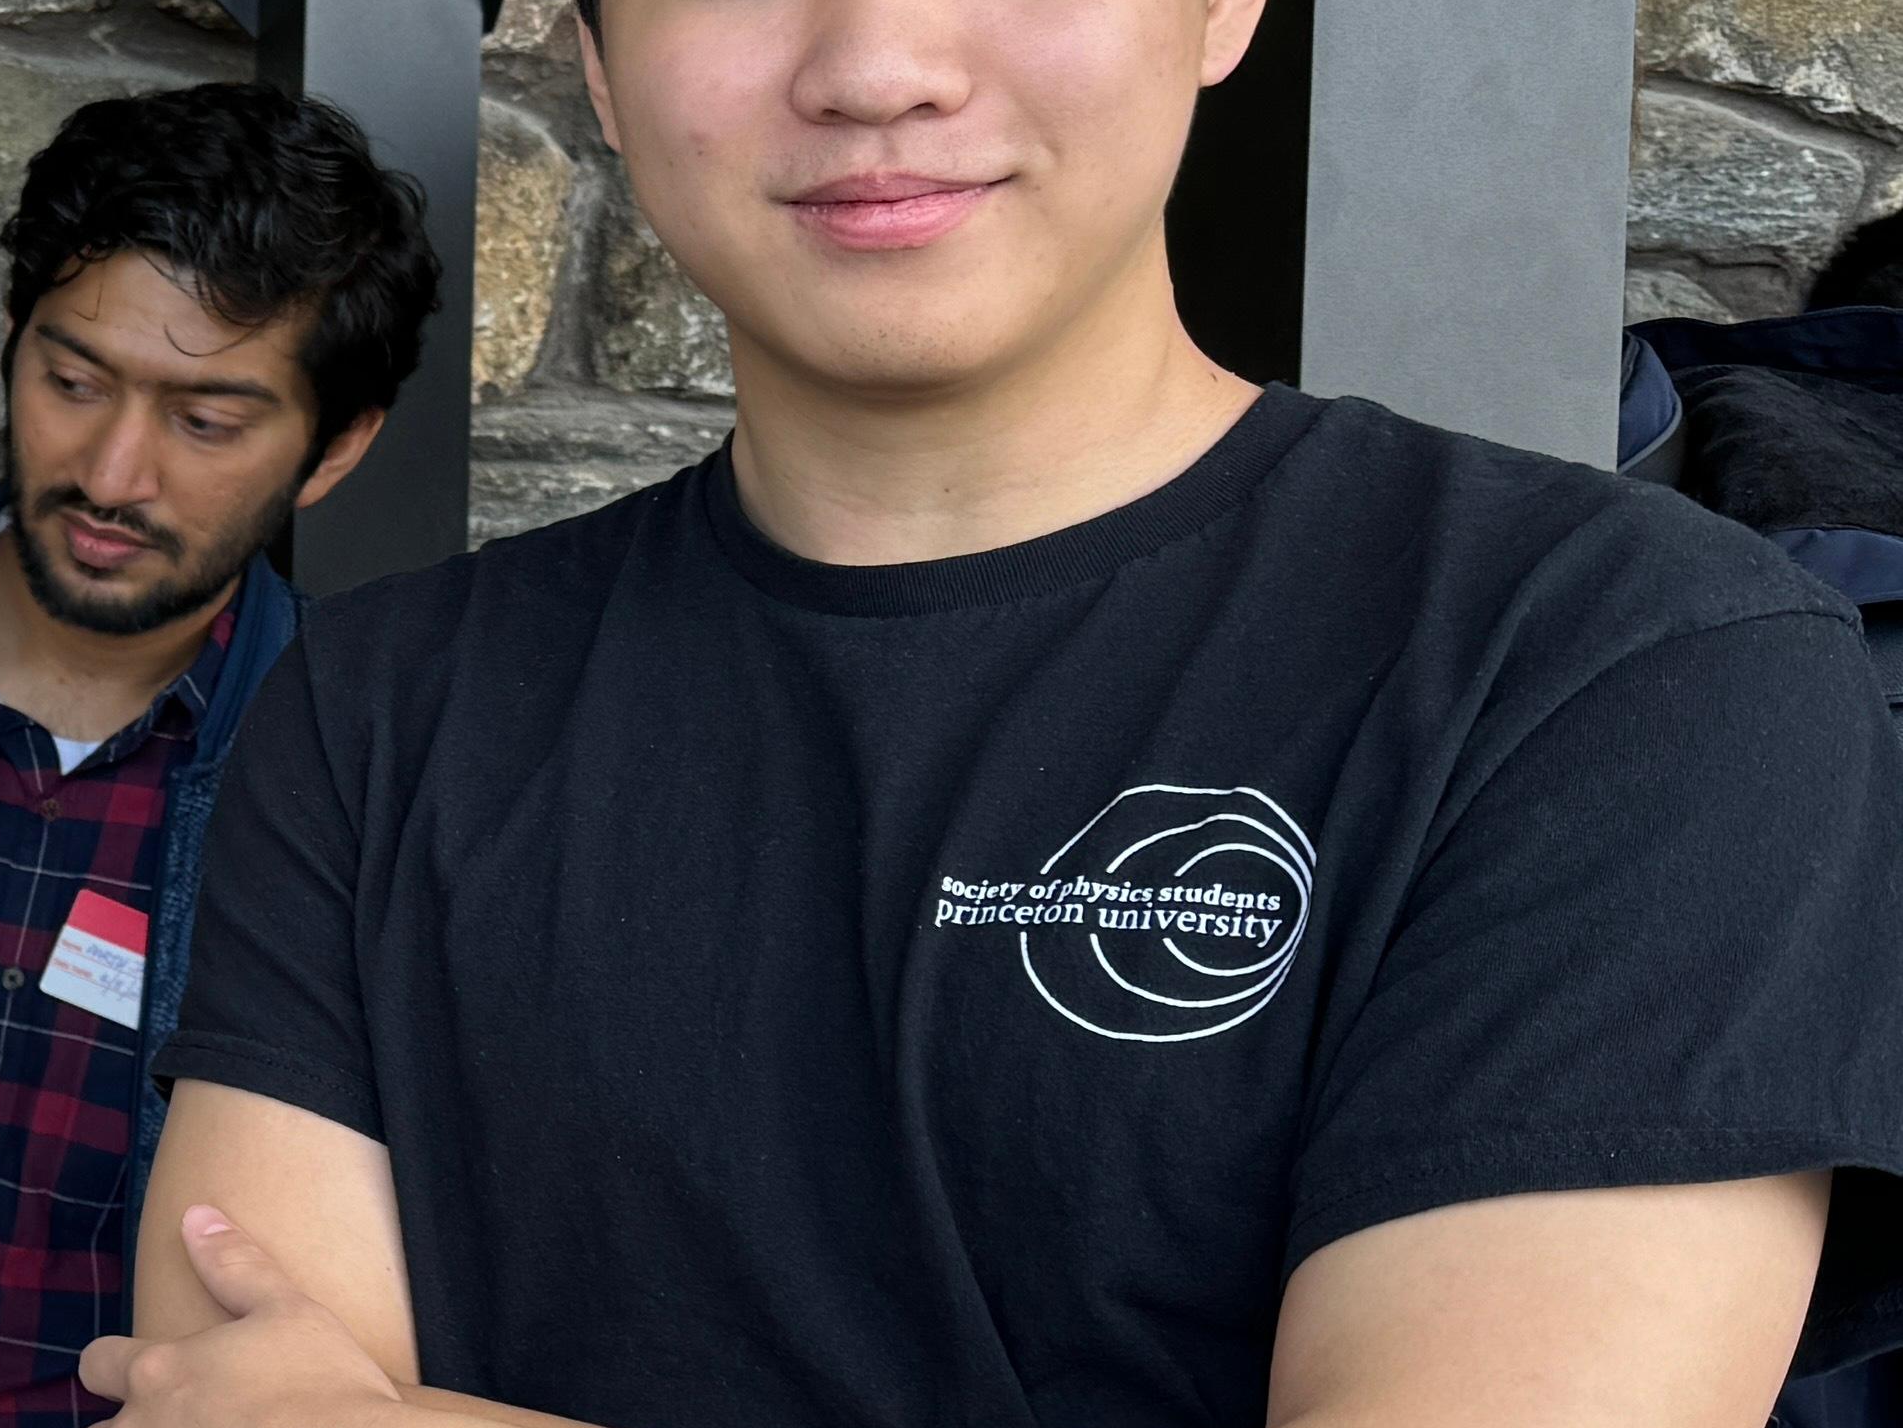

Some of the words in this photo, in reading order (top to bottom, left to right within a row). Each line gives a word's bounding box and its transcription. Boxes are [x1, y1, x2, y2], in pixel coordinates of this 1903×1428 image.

[941, 876, 1026, 902] society
[1029, 879, 1062, 900] of
[1057, 875, 1153, 903] physics
[1157, 884, 1281, 911] students
[934, 899, 1084, 928] princeton
[1096, 902, 1283, 948] university
